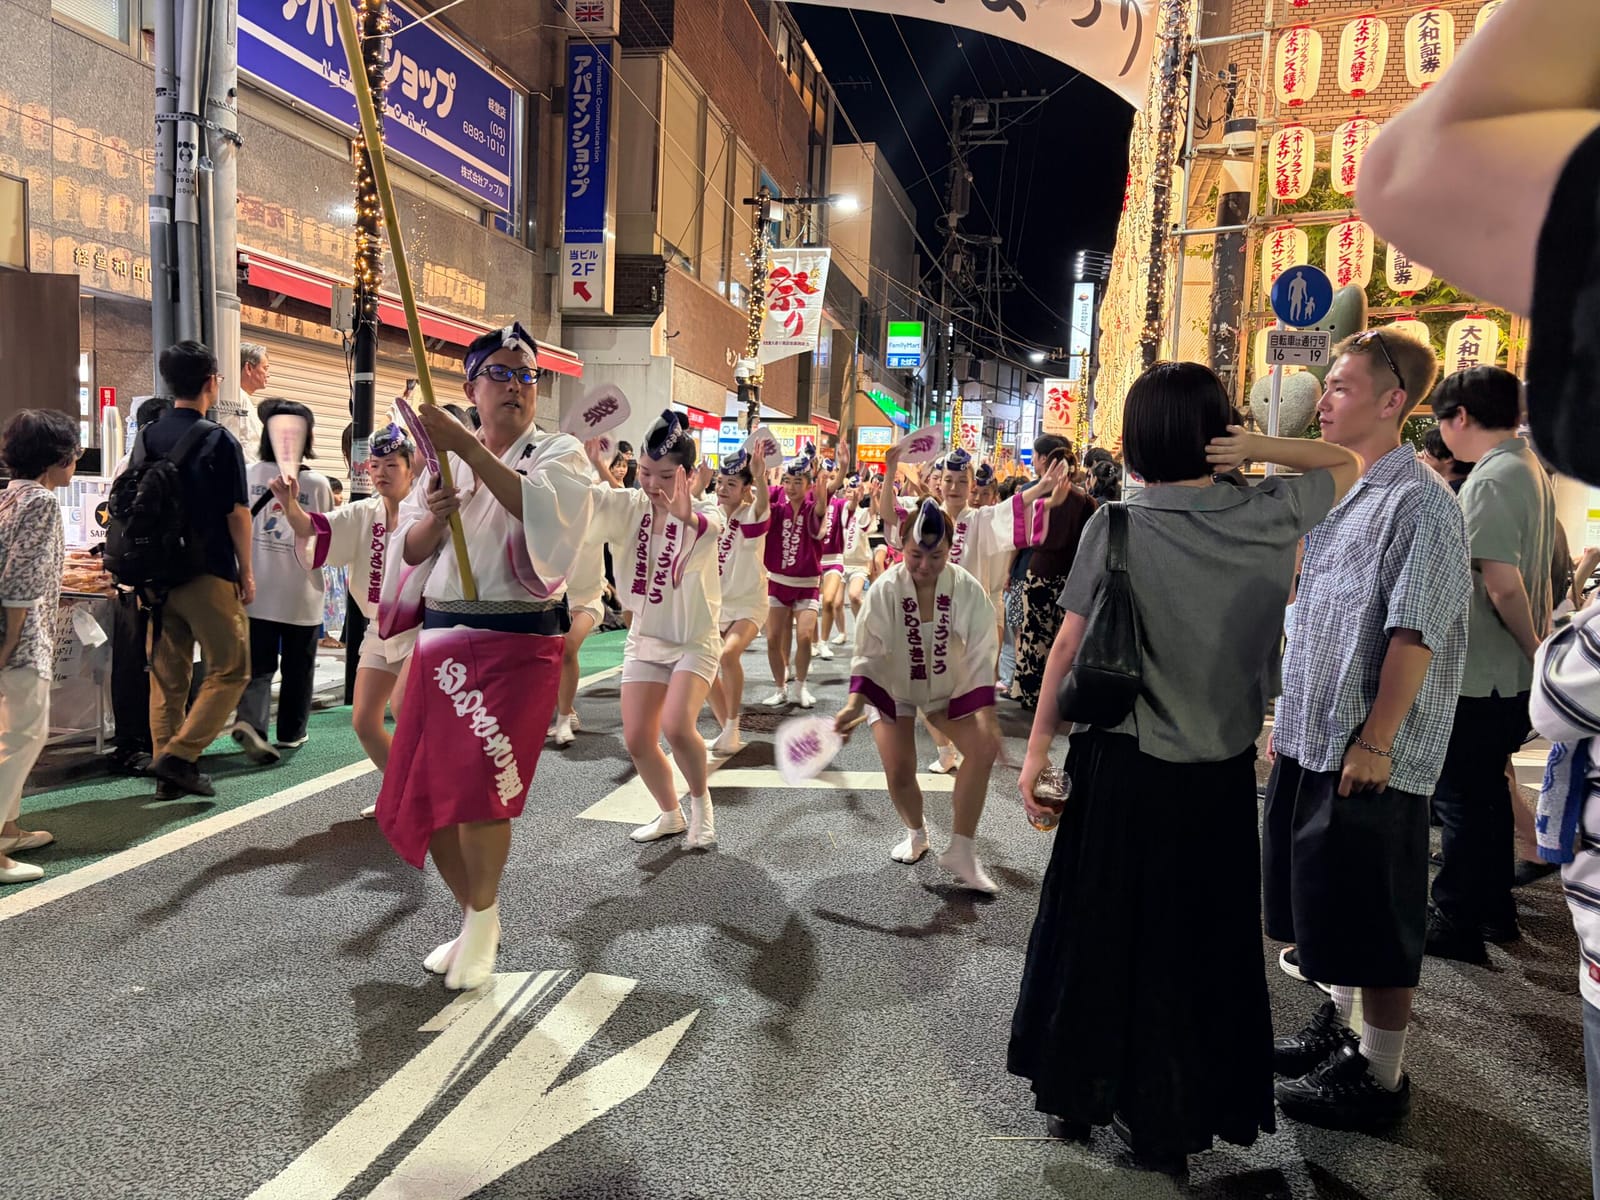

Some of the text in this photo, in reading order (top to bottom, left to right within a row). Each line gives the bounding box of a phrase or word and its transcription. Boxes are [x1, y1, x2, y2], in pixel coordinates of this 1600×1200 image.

[1418, 12, 1441, 73] 大和証券
[463, 121, 506, 157] 6893-1010
[490, 120, 506, 142] (03)
[572, 55, 592, 198] アパマンショップ
[594, 97, 603, 163] Communication
[461, 164, 505, 198] 株式会社アップル
[569, 249, 599, 260] 当ビル
[571, 263, 597, 276] 2F
[767, 266, 821, 338] 祭り
[1271, 335, 1327, 347] 自転車は通行可
[1273, 348, 1285, 361] 16
[1310, 349, 1322, 362] 19
[1047, 387, 1076, 425] 祭り
[648, 522, 678, 605] きょうどう
[932, 593, 951, 675] きょうどう
